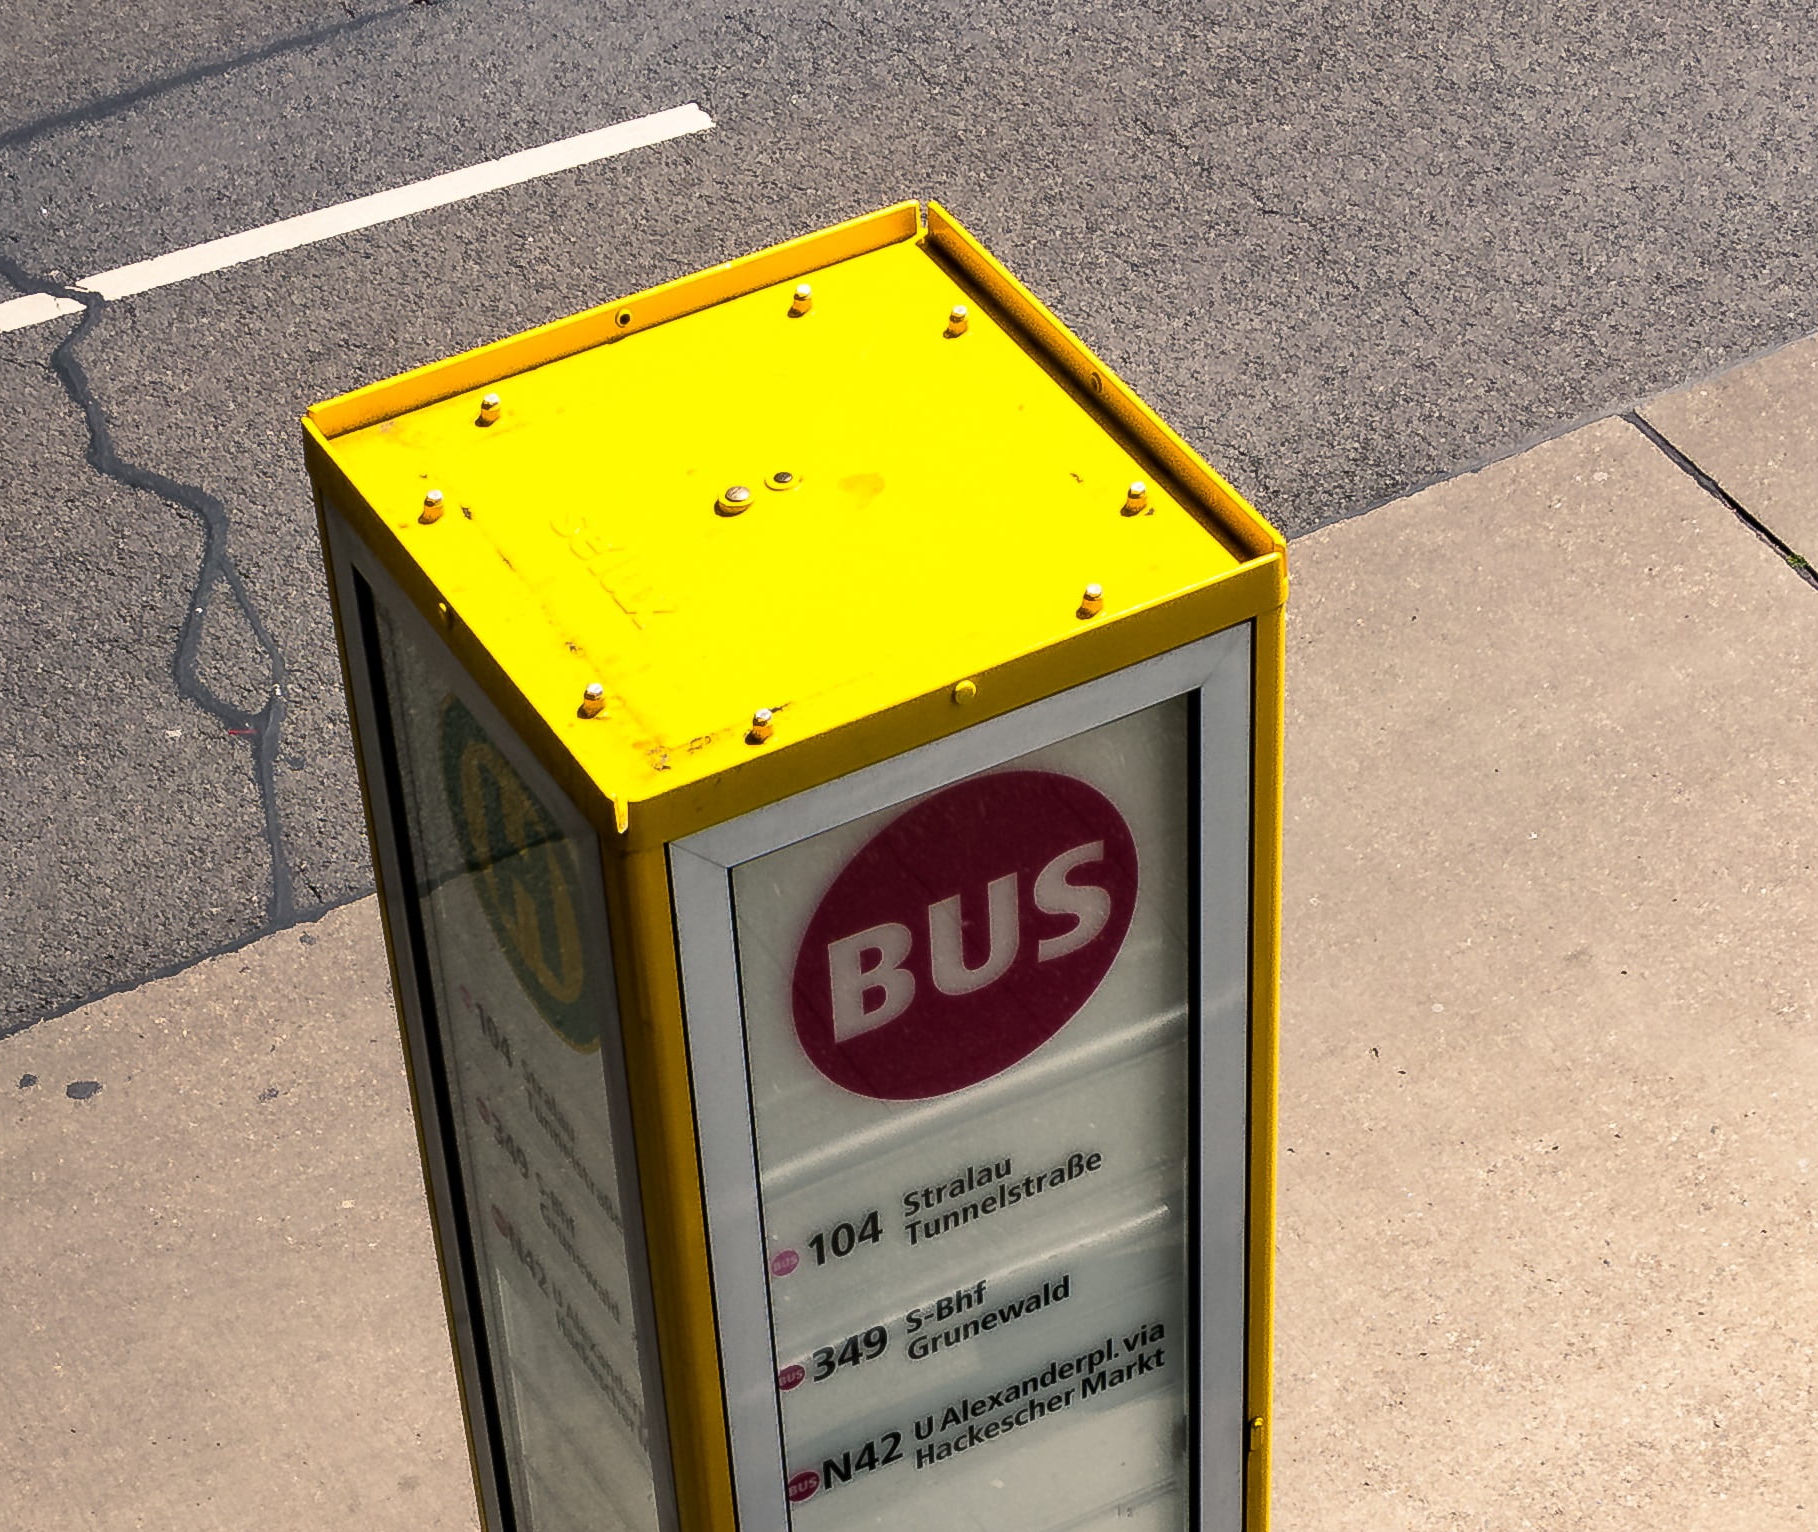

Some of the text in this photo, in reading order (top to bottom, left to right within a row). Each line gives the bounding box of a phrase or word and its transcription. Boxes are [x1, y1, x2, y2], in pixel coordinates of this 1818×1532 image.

[827, 840, 1112, 1045] BUS
[902, 1157, 1012, 1218] Stralau
[904, 1151, 1103, 1247] Tunnelstraße
[807, 1209, 883, 1267] 104
[905, 1279, 988, 1334] S-Bhf
[907, 1275, 1071, 1361] Grunewald
[811, 1325, 889, 1384] 349
[913, 1321, 1166, 1442] U Alexanderpl. via
[914, 1346, 1166, 1470] Hackescher Markt
[788, 1431, 905, 1497] BUS N42
